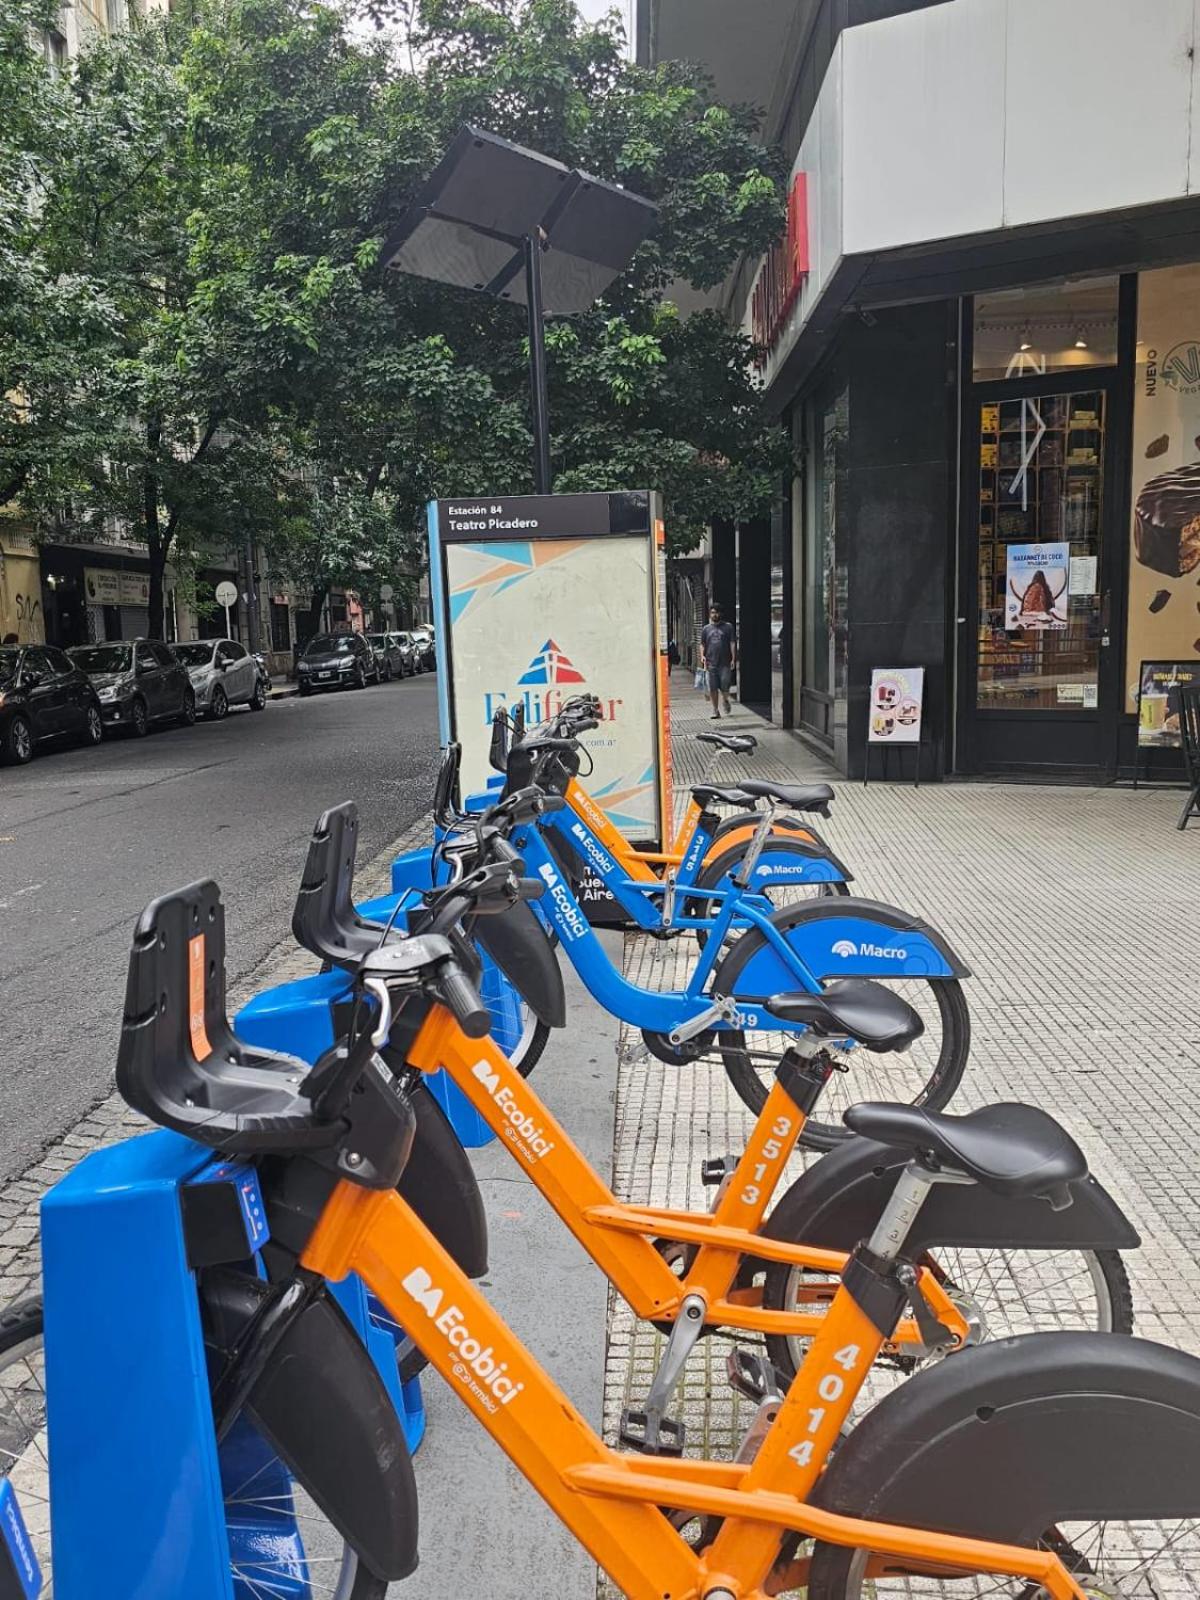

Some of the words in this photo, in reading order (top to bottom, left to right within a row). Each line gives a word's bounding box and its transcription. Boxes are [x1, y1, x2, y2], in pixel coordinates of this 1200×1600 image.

[1146, 350, 1157, 396] NUEVO
[1179, 385, 1200, 394] VEG
[449, 505, 487, 515] Estación
[490, 505, 502, 514] 84
[449, 520, 486, 530] Teatro
[488, 518, 538, 529] Picadero
[484, 689, 623, 725] Edifir
[571, 823, 586, 841] BA
[583, 836, 614, 873] Ecobici
[685, 835, 704, 871] 3145
[774, 865, 802, 875] Macro
[538, 862, 558, 889] BA
[550, 884, 589, 938] Ecobici
[583, 888, 614, 901] Aire
[860, 943, 907, 960] Macro
[471, 1059, 500, 1095] BA
[493, 1086, 555, 1158] Ecobici
[741, 1116, 793, 1206] 3513
[401, 1266, 444, 1318] BA
[435, 1304, 525, 1405] Ecobici
[787, 1343, 861, 1466] 4014
